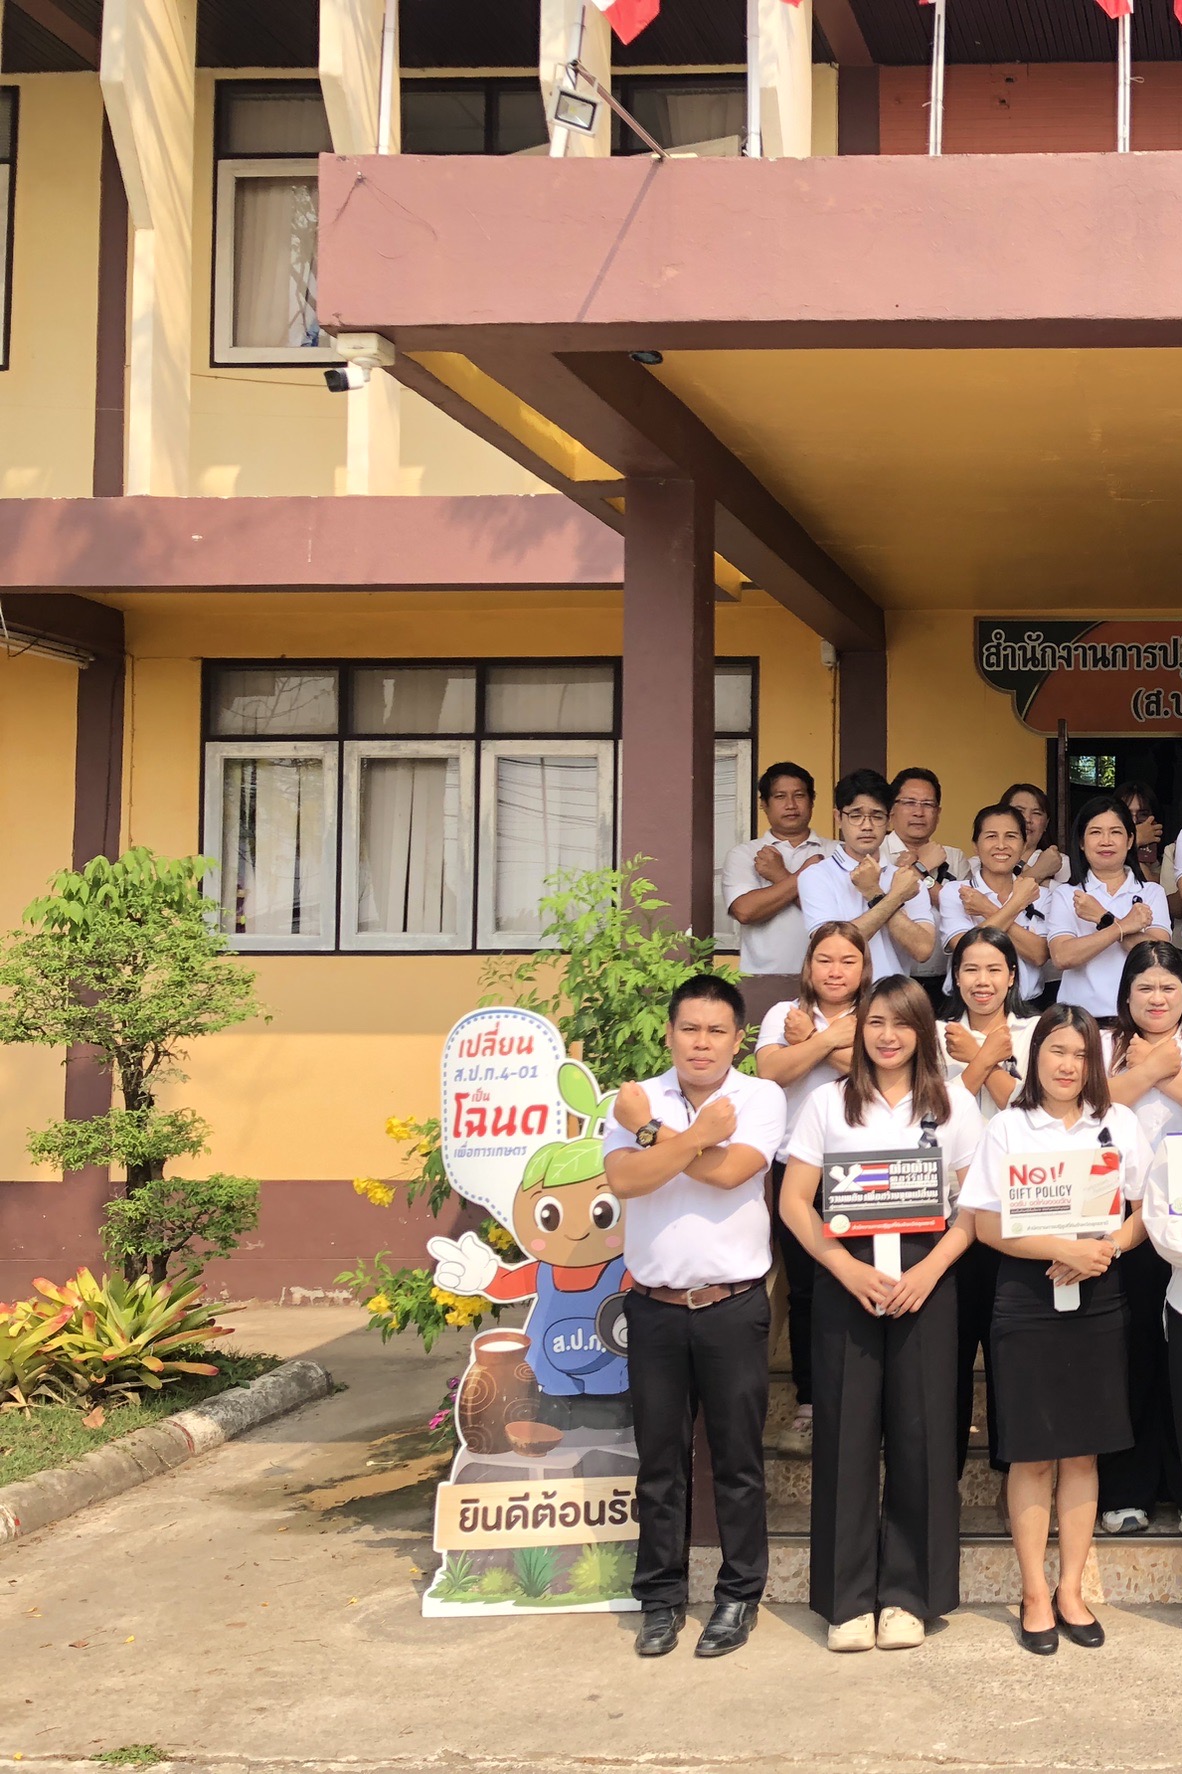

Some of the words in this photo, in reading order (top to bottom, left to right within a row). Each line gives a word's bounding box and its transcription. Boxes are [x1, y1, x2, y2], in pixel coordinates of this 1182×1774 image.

[458, 1021, 534, 1058] เปลี่ยน
[454, 1065, 538, 1082] ส.ป.ก.4-01
[471, 1087, 490, 1102] เป็น
[453, 1092, 549, 1138] โฉนด
[454, 1141, 527, 1158] เพื่อการเกษตร
[1009, 1187, 1031, 1200] GIFT
[1035, 1184, 1073, 1199] POLICY
